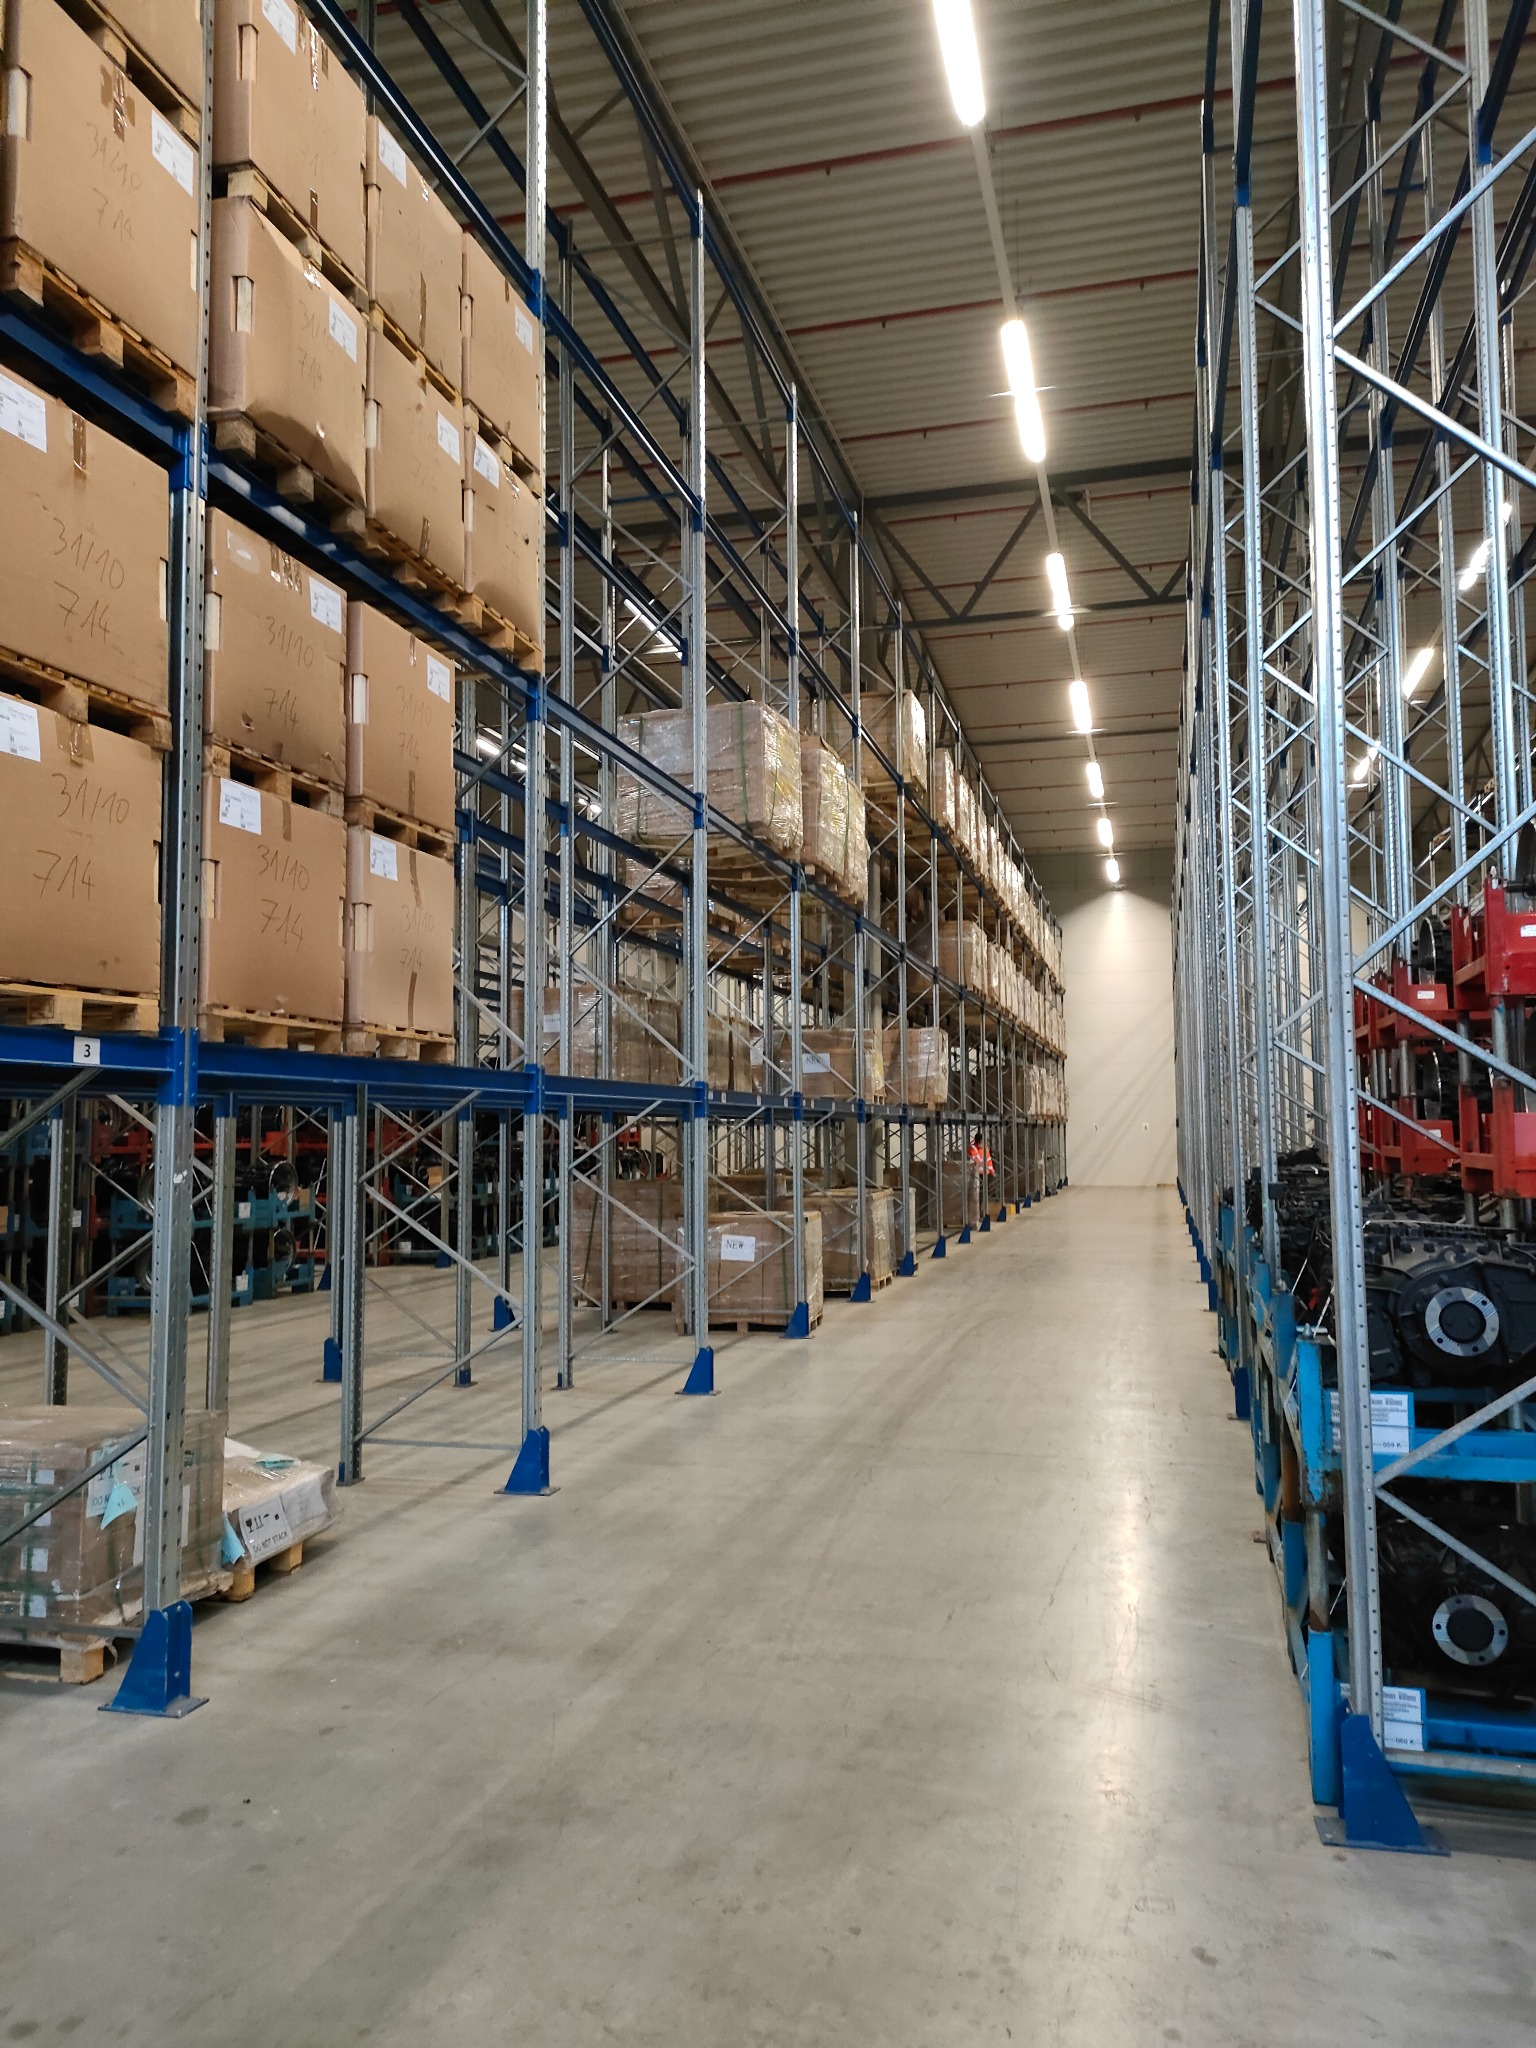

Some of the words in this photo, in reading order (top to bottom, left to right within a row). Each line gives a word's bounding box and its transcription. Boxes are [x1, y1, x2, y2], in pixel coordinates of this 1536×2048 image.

[53, 517, 124, 590] 31/10
[53, 580, 110, 643] 714
[266, 615, 314, 667] 31/10
[263, 687, 299, 736] 714
[51, 772, 130, 824] 31/10
[32, 848, 97, 901] 714
[257, 843, 310, 891] 31/10
[261, 898, 304, 952] 714
[83, 1043, 91, 1058] 3
[726, 1239, 744, 1250] NEW
[271, 1530, 288, 1545] STACK
